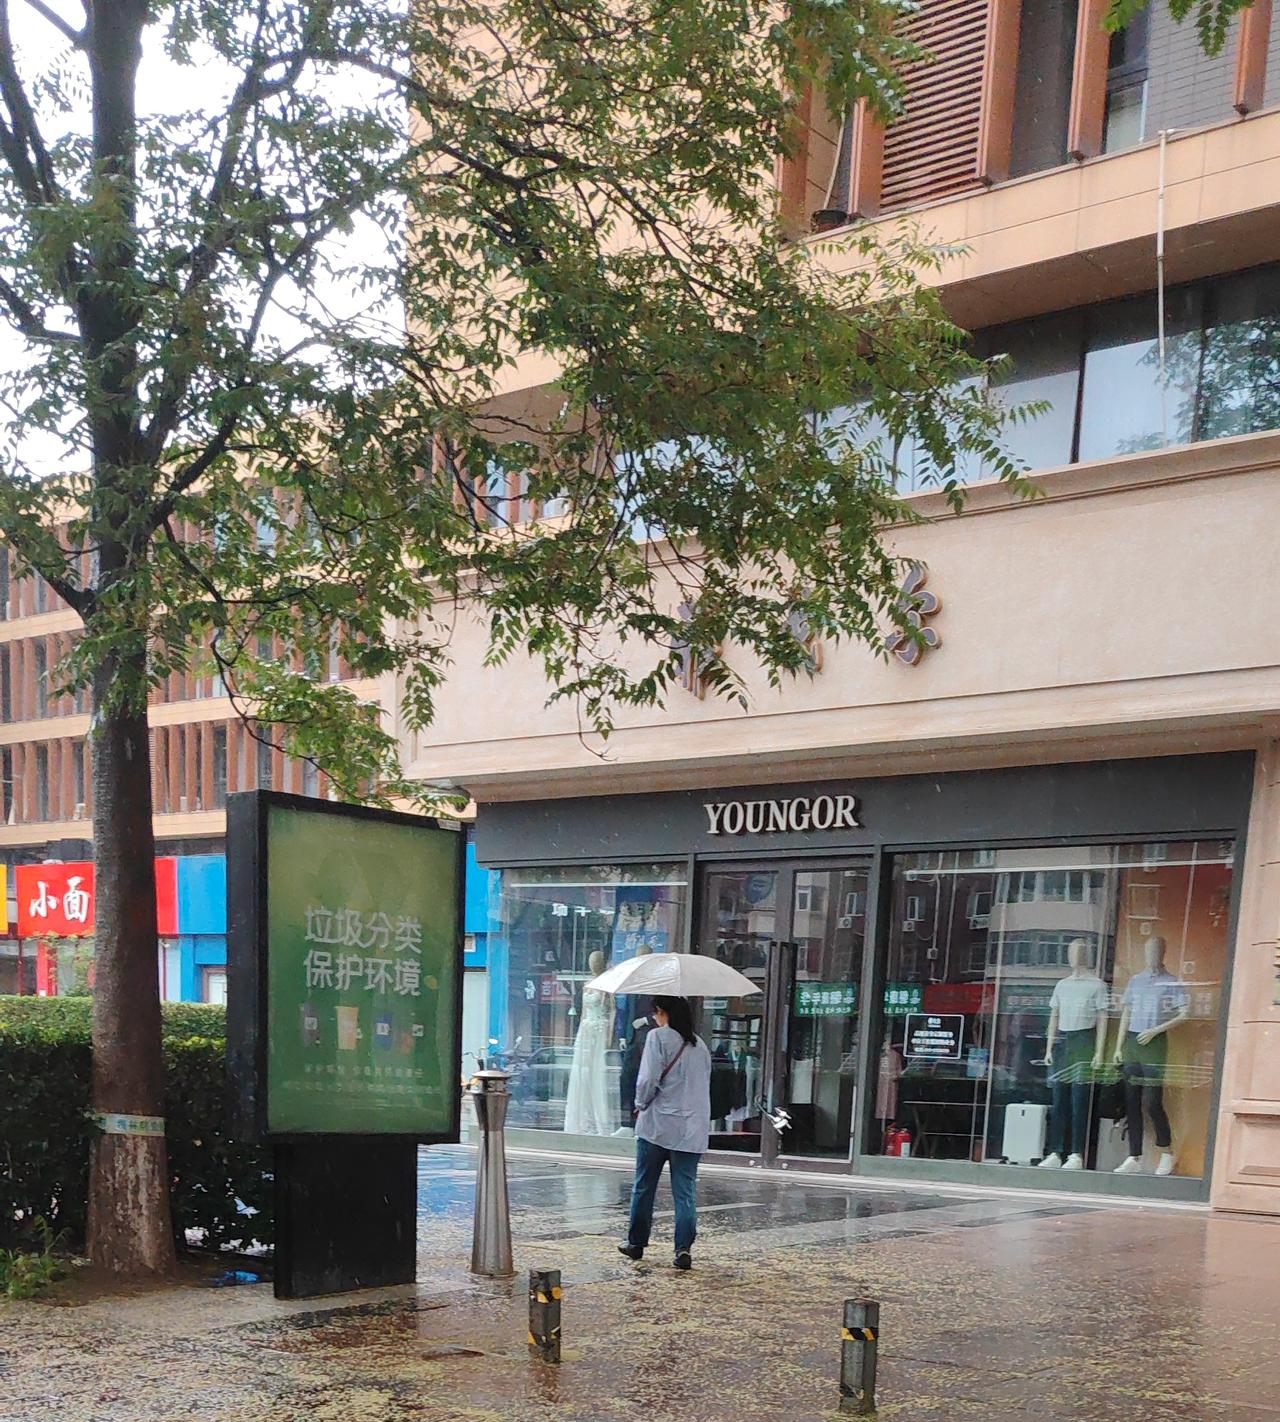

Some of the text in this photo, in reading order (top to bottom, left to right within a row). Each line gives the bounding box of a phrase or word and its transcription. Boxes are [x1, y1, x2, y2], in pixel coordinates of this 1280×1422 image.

[703, 795, 858, 834] YOUNGOR
[30, 876, 90, 923] 小面
[304, 906, 423, 954] 垃圾分类
[304, 949, 422, 996] 保护环境
